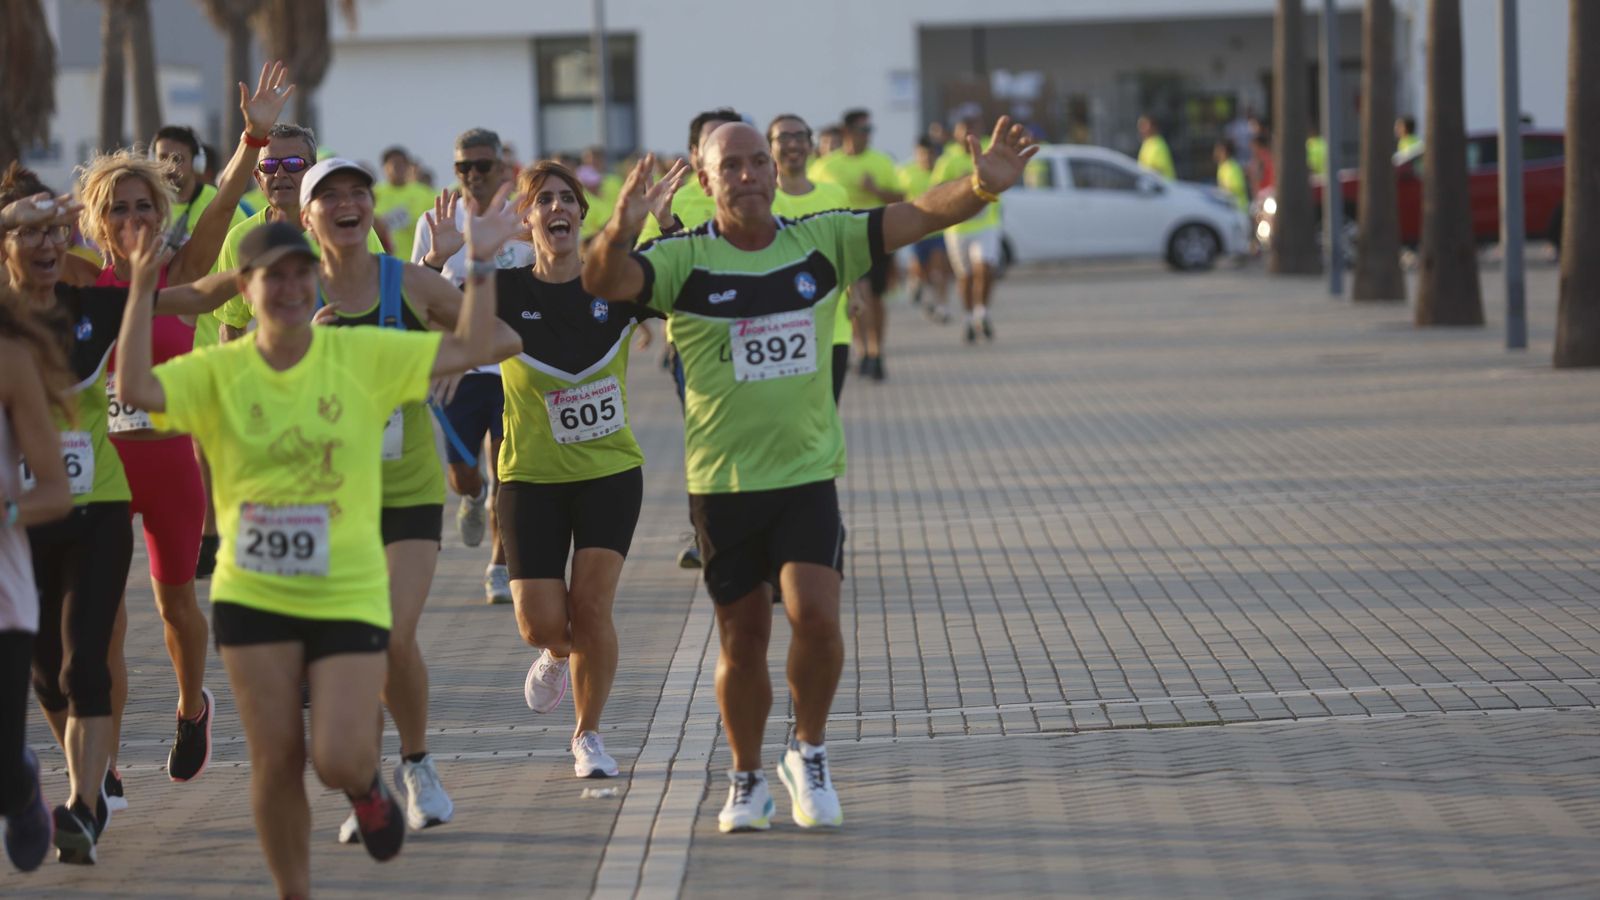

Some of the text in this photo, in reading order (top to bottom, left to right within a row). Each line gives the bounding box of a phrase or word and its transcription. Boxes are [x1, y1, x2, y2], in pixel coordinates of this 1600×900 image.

[745, 333, 807, 365] 892
[560, 394, 579, 404] POR
[580, 391, 591, 400] LA
[560, 396, 616, 430] 605
[246, 528, 315, 561] 299
